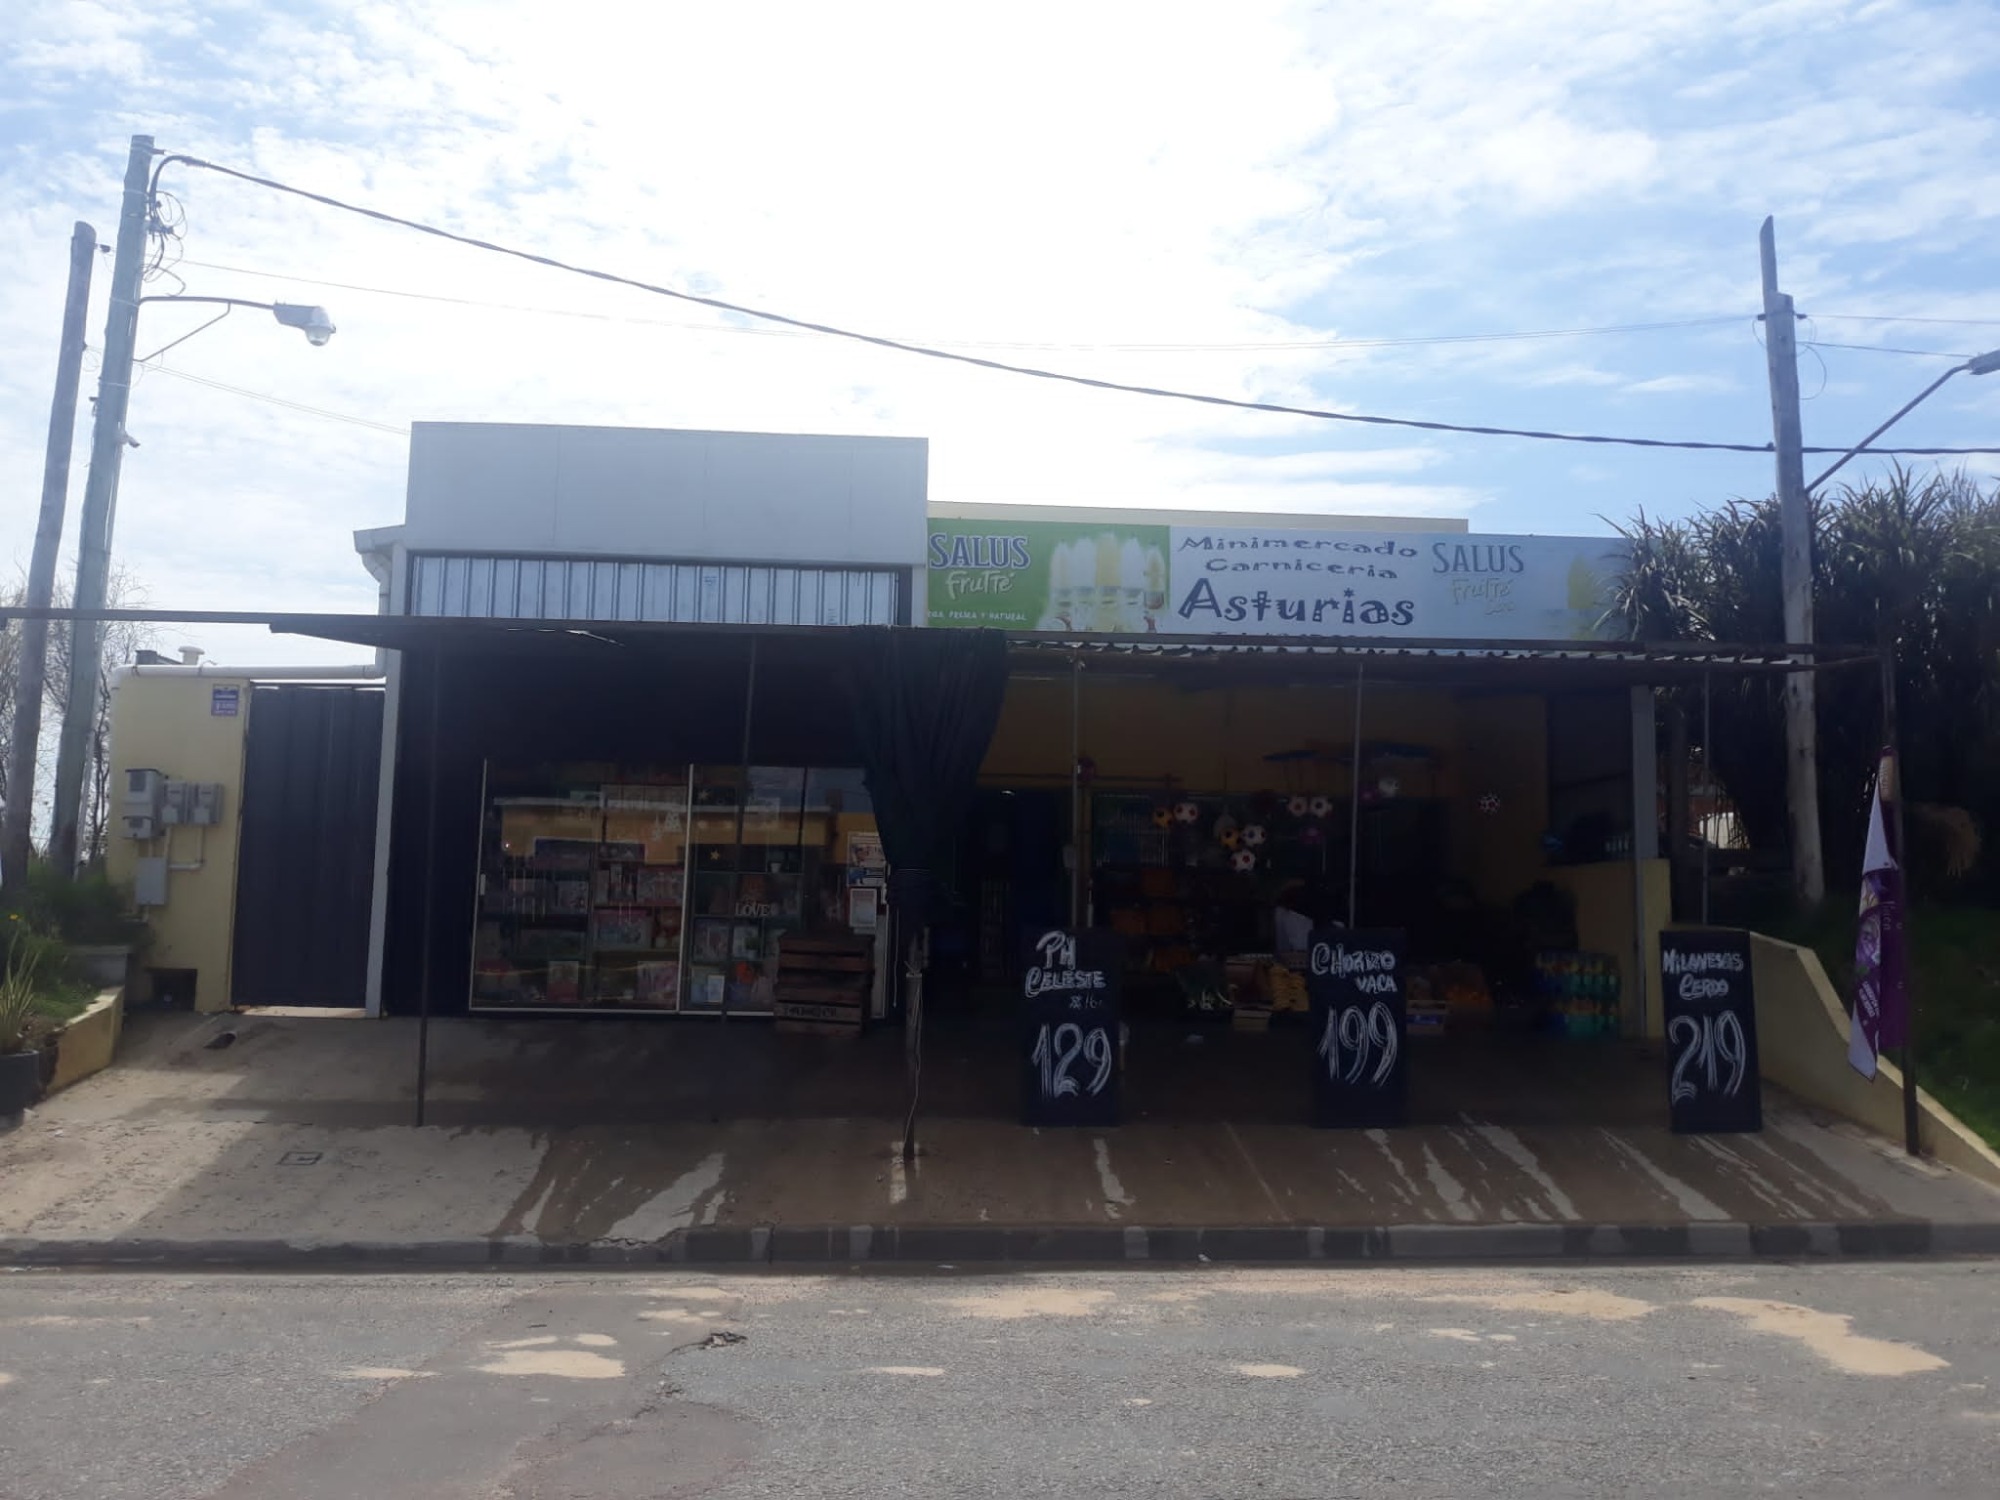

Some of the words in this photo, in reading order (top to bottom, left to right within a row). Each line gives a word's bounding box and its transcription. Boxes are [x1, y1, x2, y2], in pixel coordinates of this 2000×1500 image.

[929, 533, 1030, 570] SALUS
[1179, 535, 1419, 559] Minimercado
[1432, 542, 1525, 574] SALUS
[1205, 558, 1398, 580] Carniceria
[1178, 577, 1415, 626] Asturias
[1024, 966, 1108, 999] CELESTE
[1355, 973, 1398, 995] VACA
[1031, 1022, 1112, 1100] 129
[1316, 1001, 1398, 1088] 199
[1668, 1009, 1747, 1106] 219
